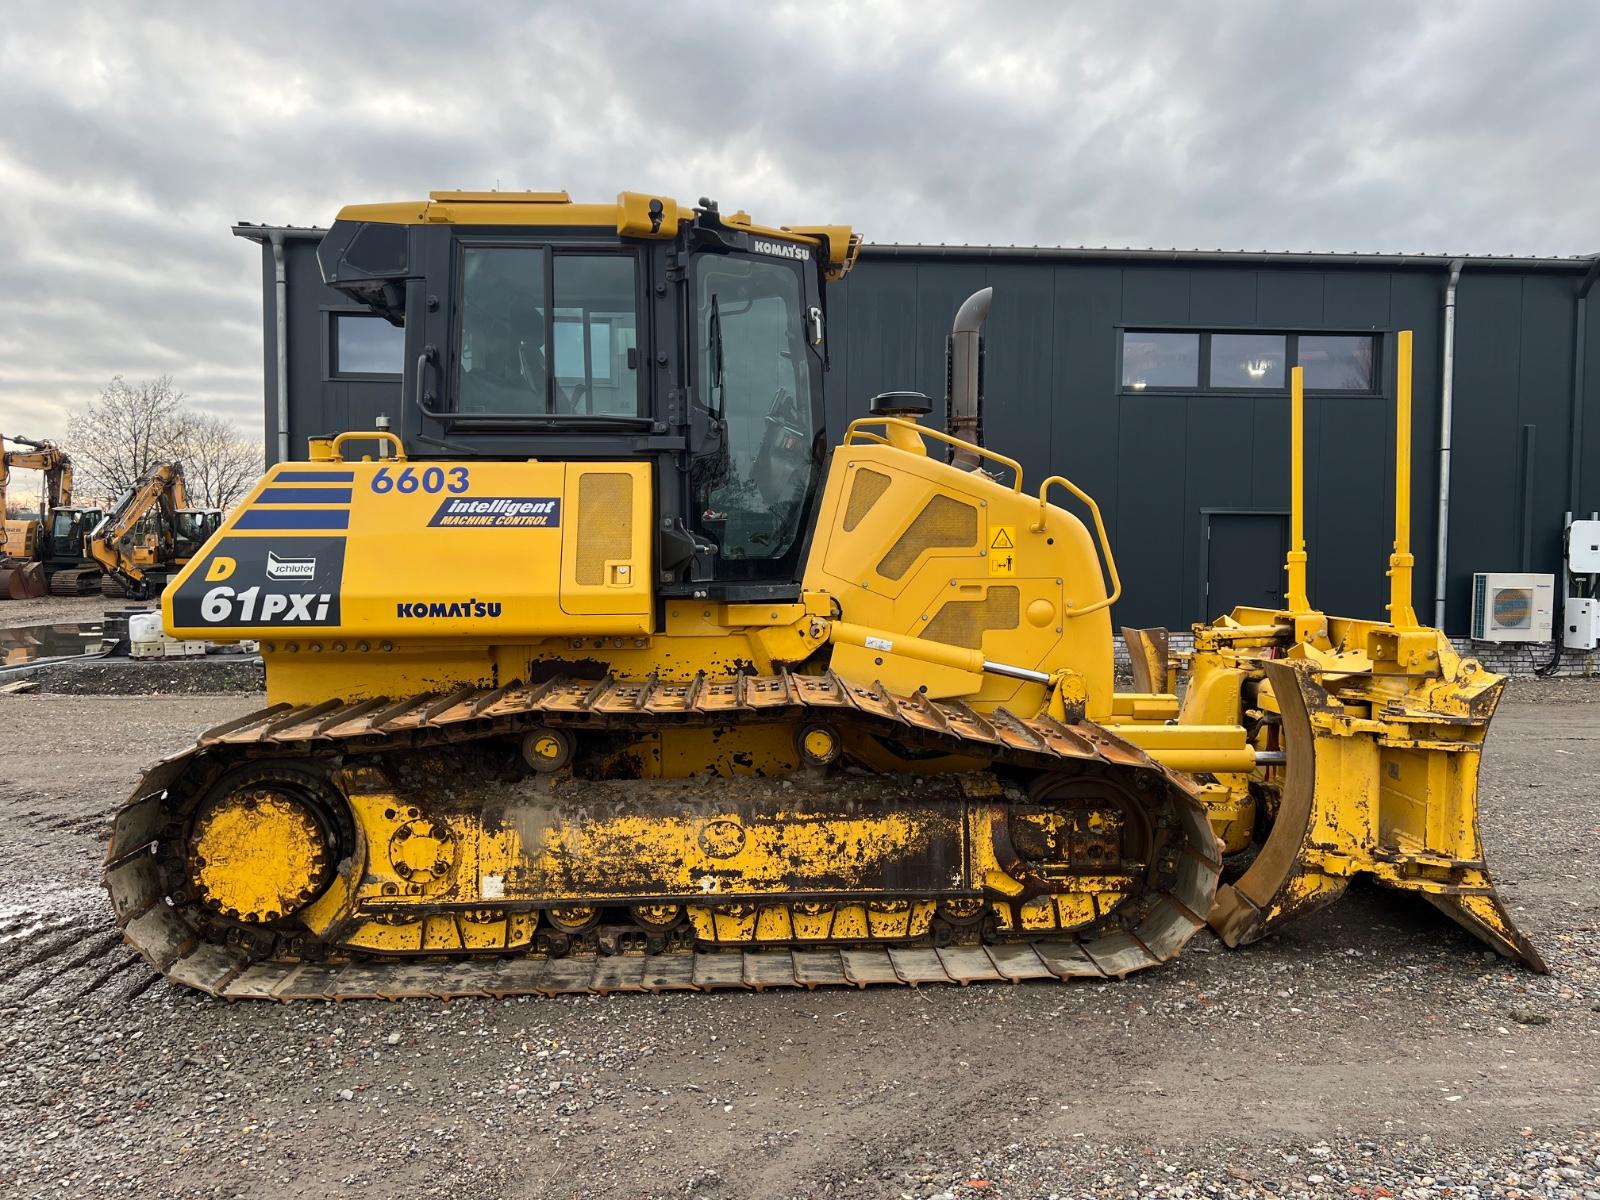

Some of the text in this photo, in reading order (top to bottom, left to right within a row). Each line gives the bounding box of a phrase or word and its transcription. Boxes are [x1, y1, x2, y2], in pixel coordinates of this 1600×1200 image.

[754, 240, 810, 261] KOMATSU
[371, 466, 470, 494] 6603
[447, 499, 555, 517] intelligent
[439, 515, 548, 526] MACHINE CONTROL
[204, 556, 237, 582] D
[397, 598, 502, 618] KOMATSU
